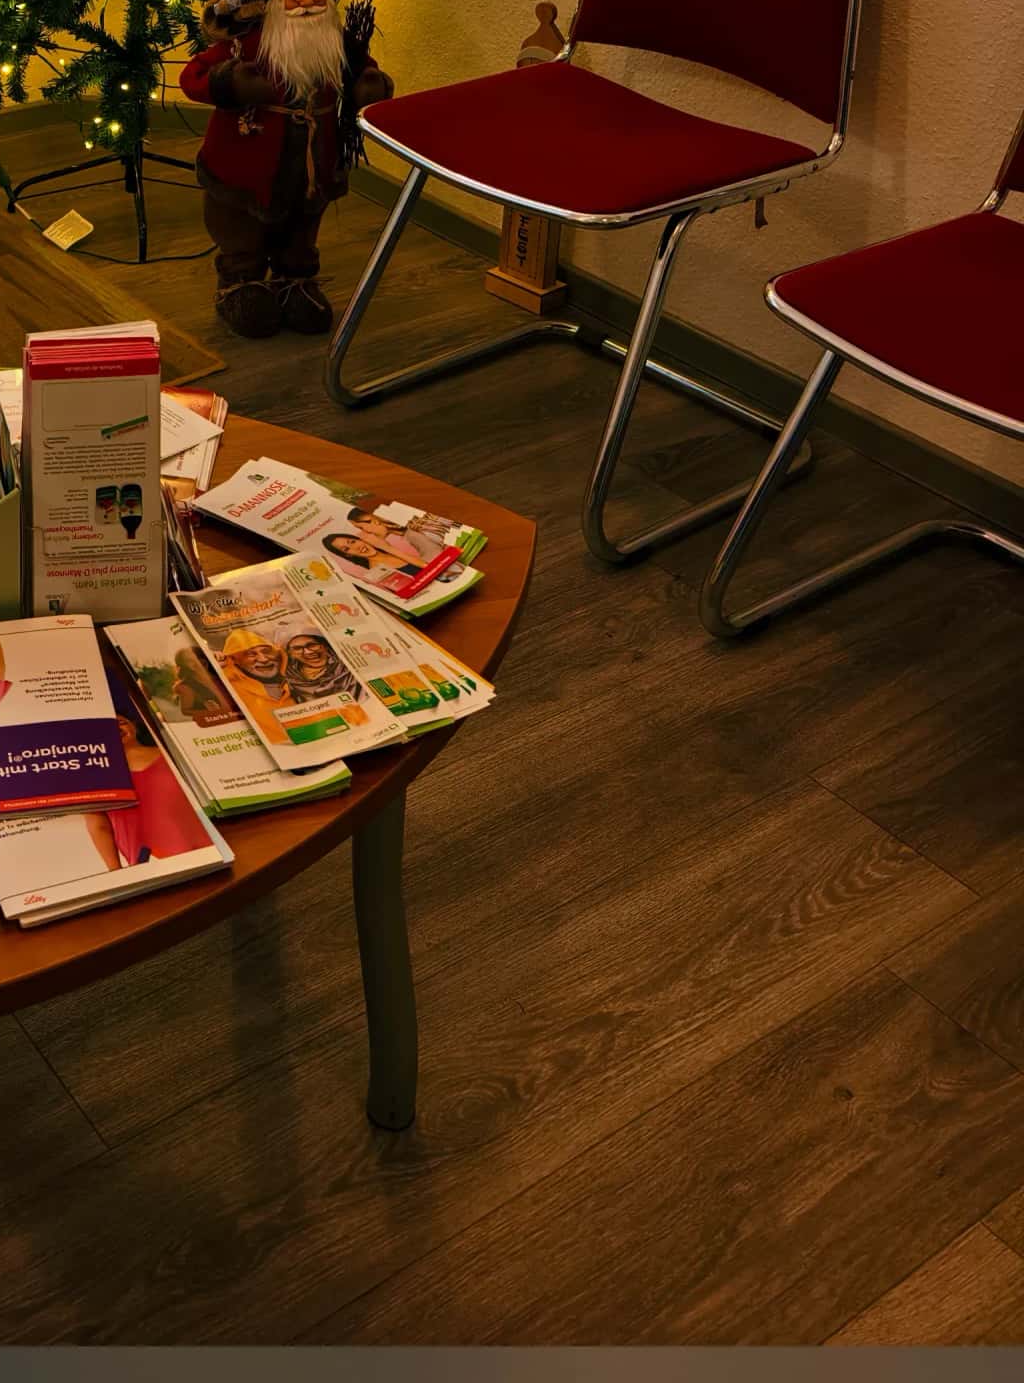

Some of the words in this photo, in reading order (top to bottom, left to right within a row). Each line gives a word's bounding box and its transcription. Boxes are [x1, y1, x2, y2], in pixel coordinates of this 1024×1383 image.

[227, 479, 288, 518] D-MANNOSE
[46, 567, 91, 577] D-Mannose
[91, 566, 109, 575] plus
[108, 564, 147, 574] Cranberry
[100, 577, 132, 587] starkes
[133, 576, 147, 586] Ein
[7, 743, 107, 763] Mounjaro®!
[201, 748, 223, 758] aus
[224, 742, 244, 754] der
[32, 759, 81, 773] Start
[85, 756, 110, 768] Ihr
